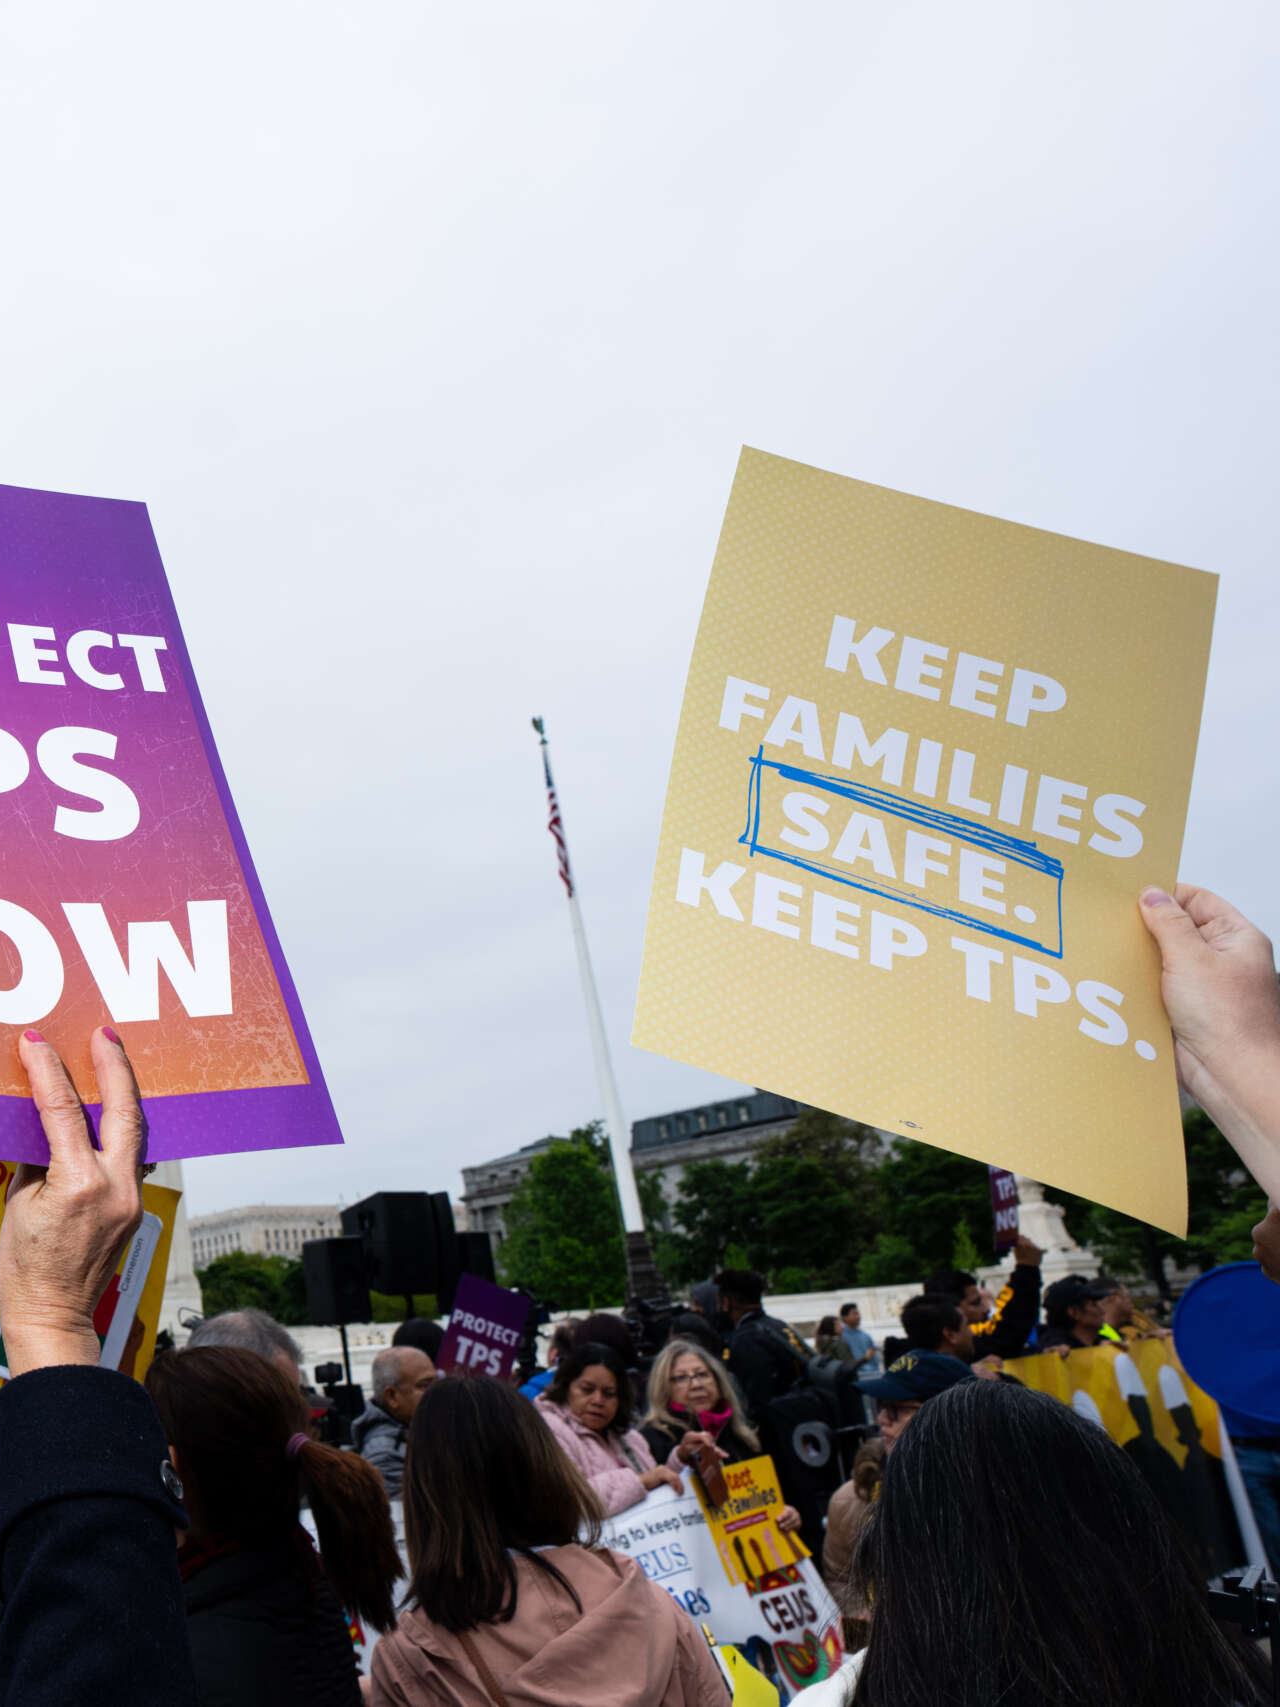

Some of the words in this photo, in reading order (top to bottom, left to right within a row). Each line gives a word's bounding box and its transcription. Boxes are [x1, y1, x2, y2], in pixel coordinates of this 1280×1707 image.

[824, 615, 1067, 727] KEEP
[719, 676, 1147, 858] FAMILIES
[778, 791, 1037, 924] SAFE.
[675, 848, 928, 971] KEEP
[952, 936, 1157, 1061] TPS.
[120, 1238, 144, 1292] Cameroon
[452, 1308, 520, 1347] PROTECT
[456, 1335, 503, 1376] TPS
[726, 1467, 755, 1490] tect
[629, 1528, 645, 1541] to
[645, 1516, 681, 1535] keep
[635, 1543, 688, 1578] EUS
[668, 1587, 711, 1616] ies
[760, 1588, 818, 1633] CEUS
